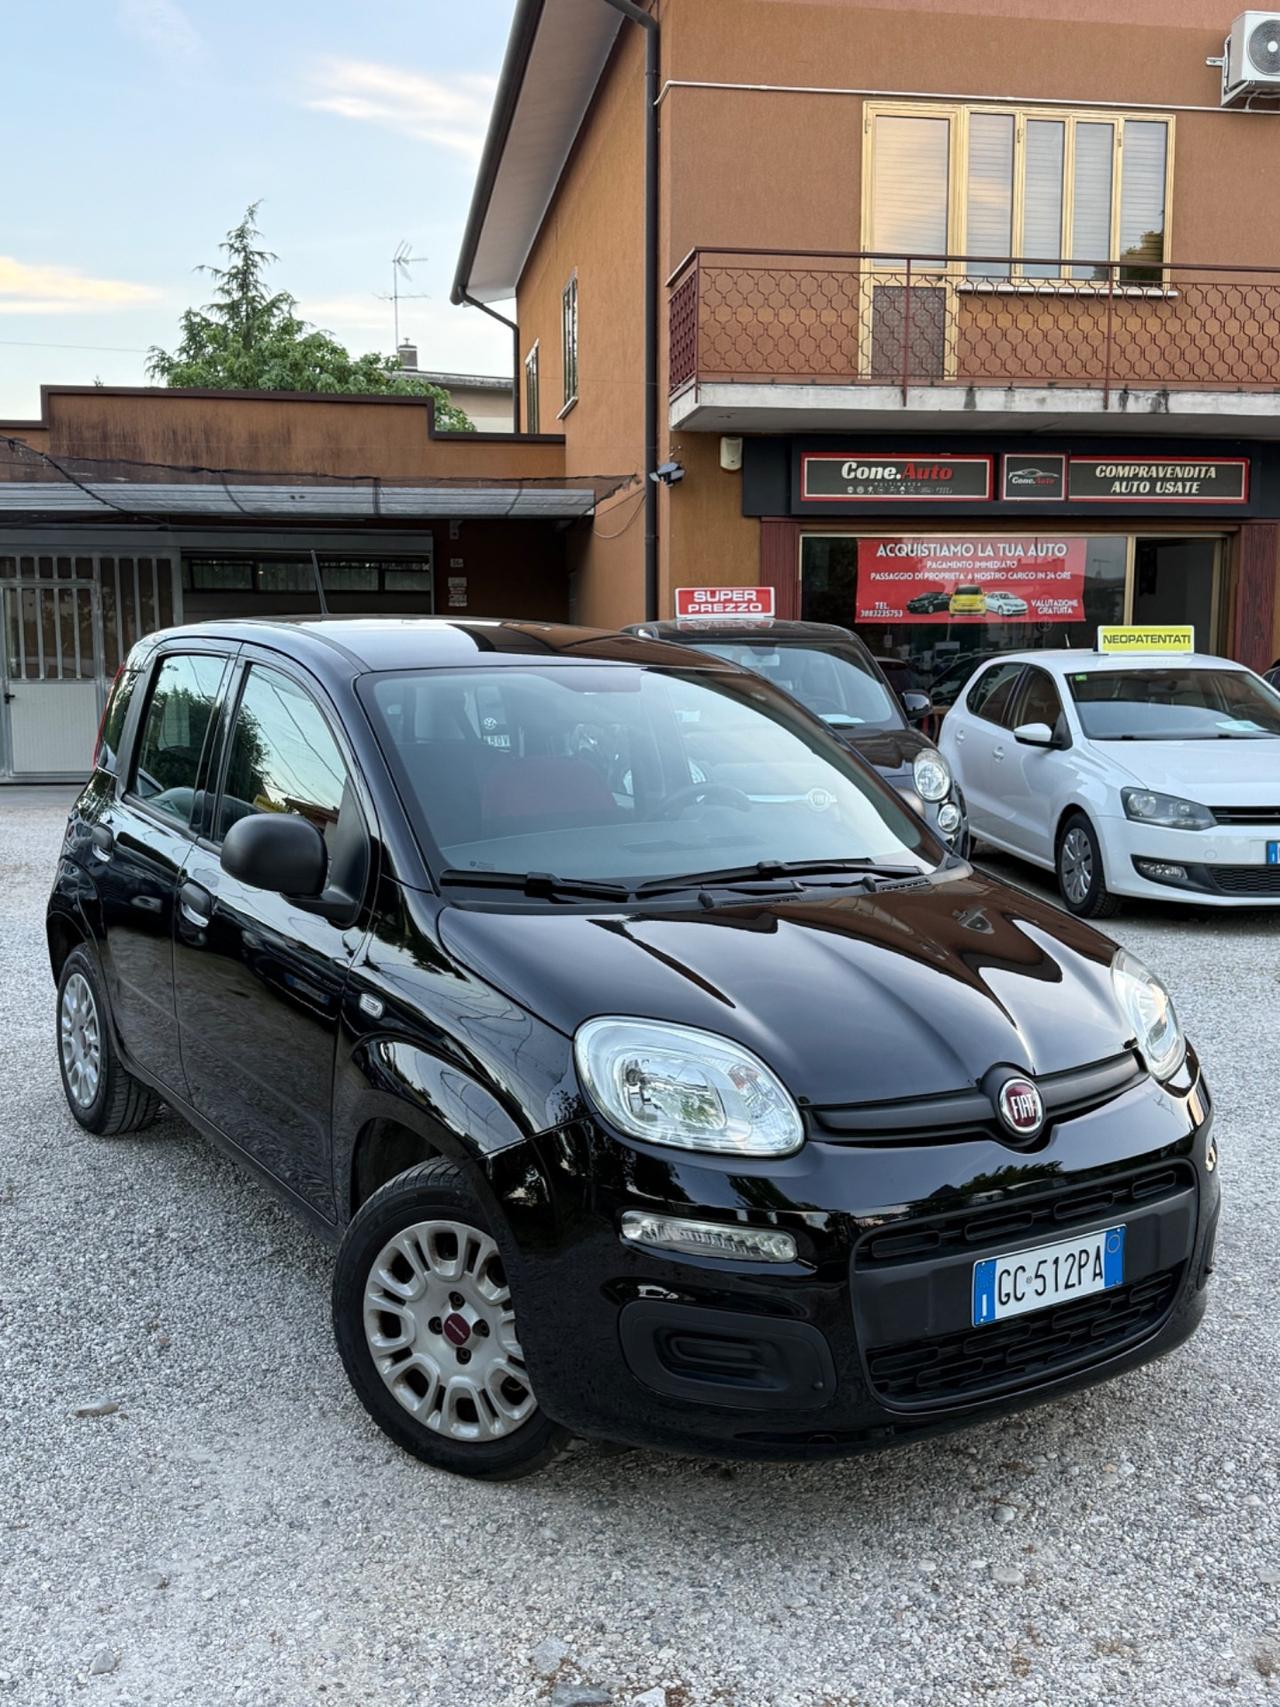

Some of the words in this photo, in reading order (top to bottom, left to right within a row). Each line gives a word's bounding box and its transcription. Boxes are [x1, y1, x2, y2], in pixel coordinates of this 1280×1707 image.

[841, 461, 953, 480] Cone.Auto
[1095, 465, 1217, 478] COMPRAVENDITA
[1110, 481, 1150, 493] AUTO
[1155, 481, 1201, 494] USATE
[876, 543, 975, 557] ACQUISTIAMO
[978, 543, 995, 557] LA
[997, 543, 1025, 557] TUA
[1027, 543, 1068, 557] AUTO
[926, 560, 974, 569] PAGAMENTO
[974, 560, 1018, 569] IMMEDIATO
[870, 571, 914, 580] PASSAGGIO
[914, 571, 923, 580] DI
[967, 571, 973, 580] A
[974, 571, 1007, 579] NOSTRO
[1007, 571, 1036, 579] CARICO
[1036, 571, 1046, 579] IN
[1046, 571, 1055, 579] 24
[1055, 571, 1071, 579] ORE
[693, 590, 757, 602] SUPER
[687, 603, 763, 613] PREZZO
[1031, 599, 1079, 608] VALUTAZIONE
[1037, 606, 1074, 615] GRATUITA
[1103, 634, 1191, 644] NEOPATENTATI
[1010, 1093, 1036, 1120] FIAT
